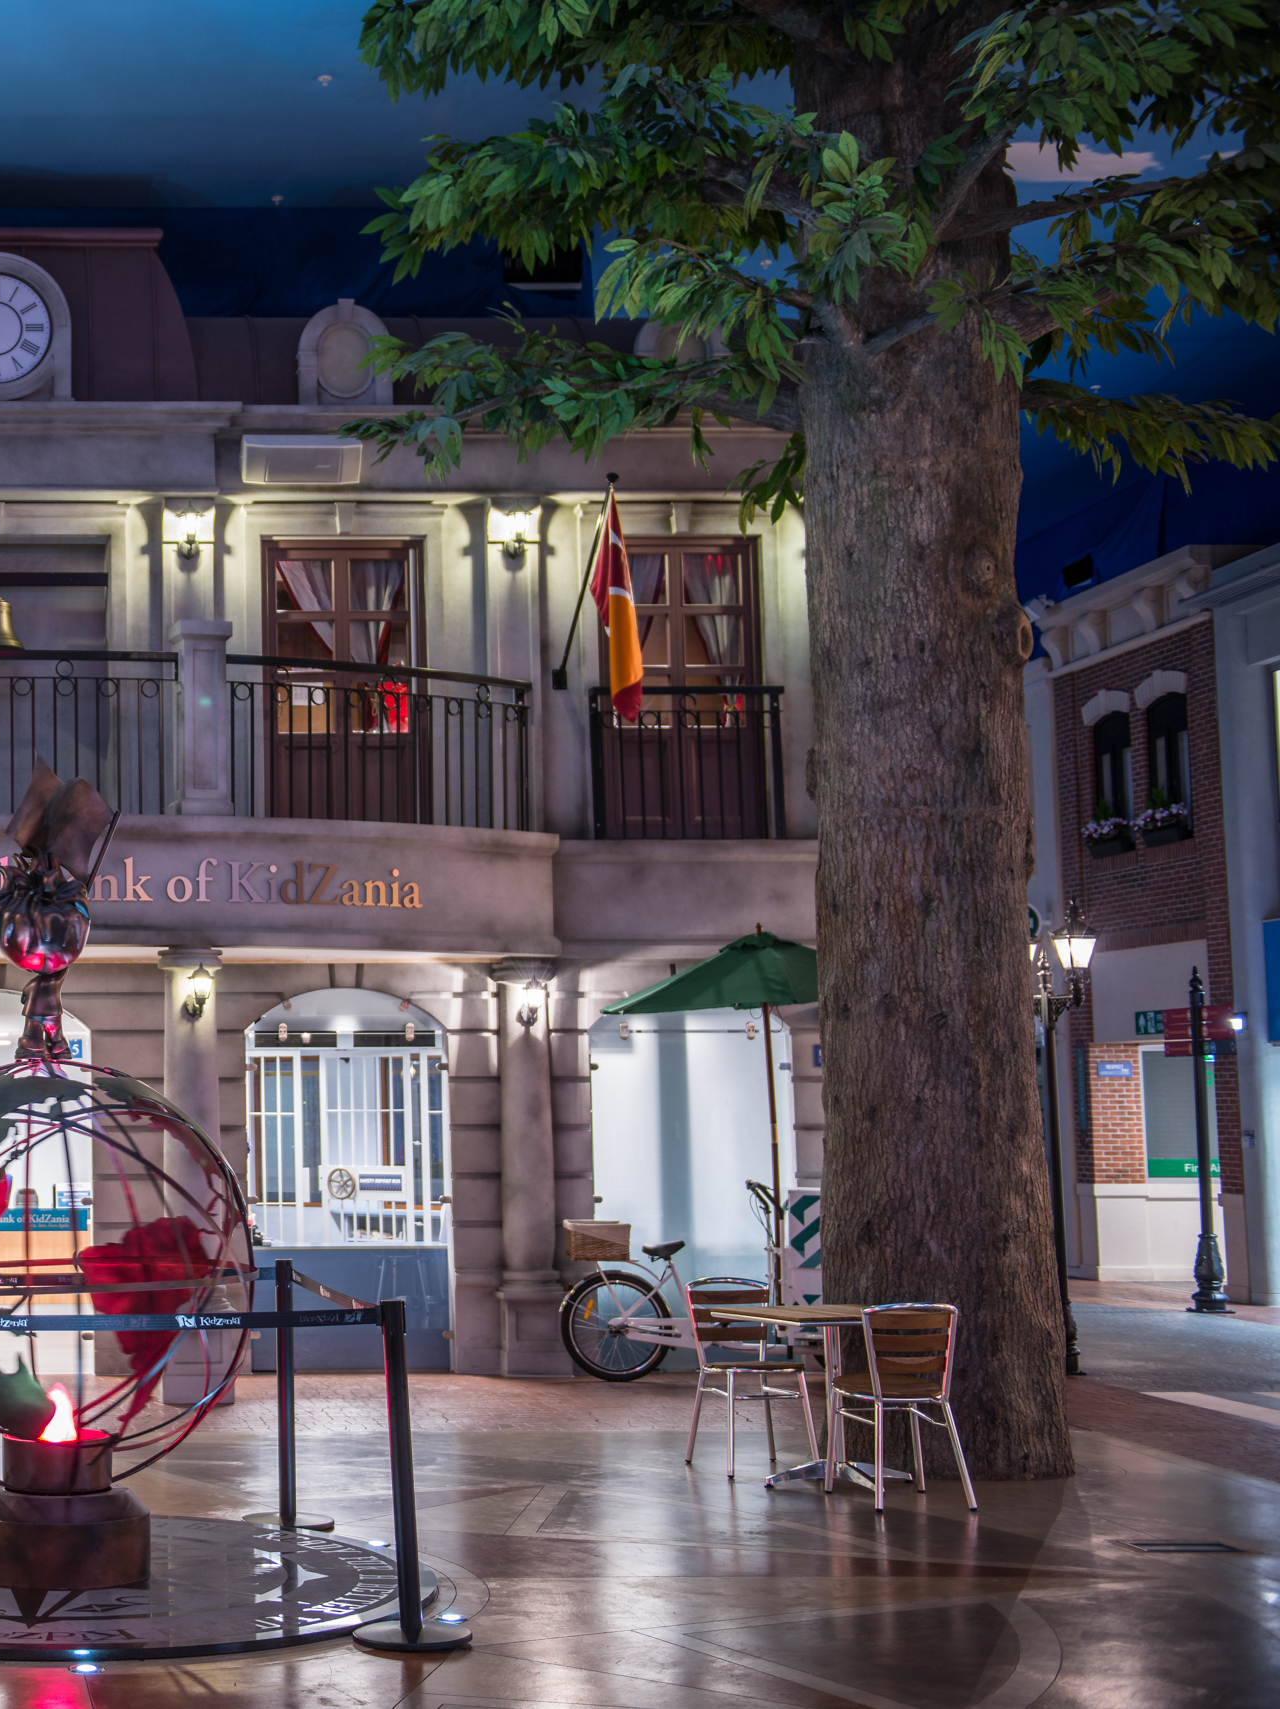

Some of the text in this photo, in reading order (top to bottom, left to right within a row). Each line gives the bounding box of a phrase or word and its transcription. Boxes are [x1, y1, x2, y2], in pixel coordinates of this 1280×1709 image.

[9, 286, 19, 302] I
[20, 302, 38, 314] II
[25, 323, 44, 332] III
[20, 338, 40, 356] IIII
[11, 355, 24, 372] V
[166, 857, 218, 903] of
[227, 860, 424, 909] KidZania
[72, 1044, 79, 1055] 5
[1184, 1163, 1199, 1172] Fir
[28, 1214, 70, 1223] KidZania
[200, 1316, 242, 1326] KidZania
